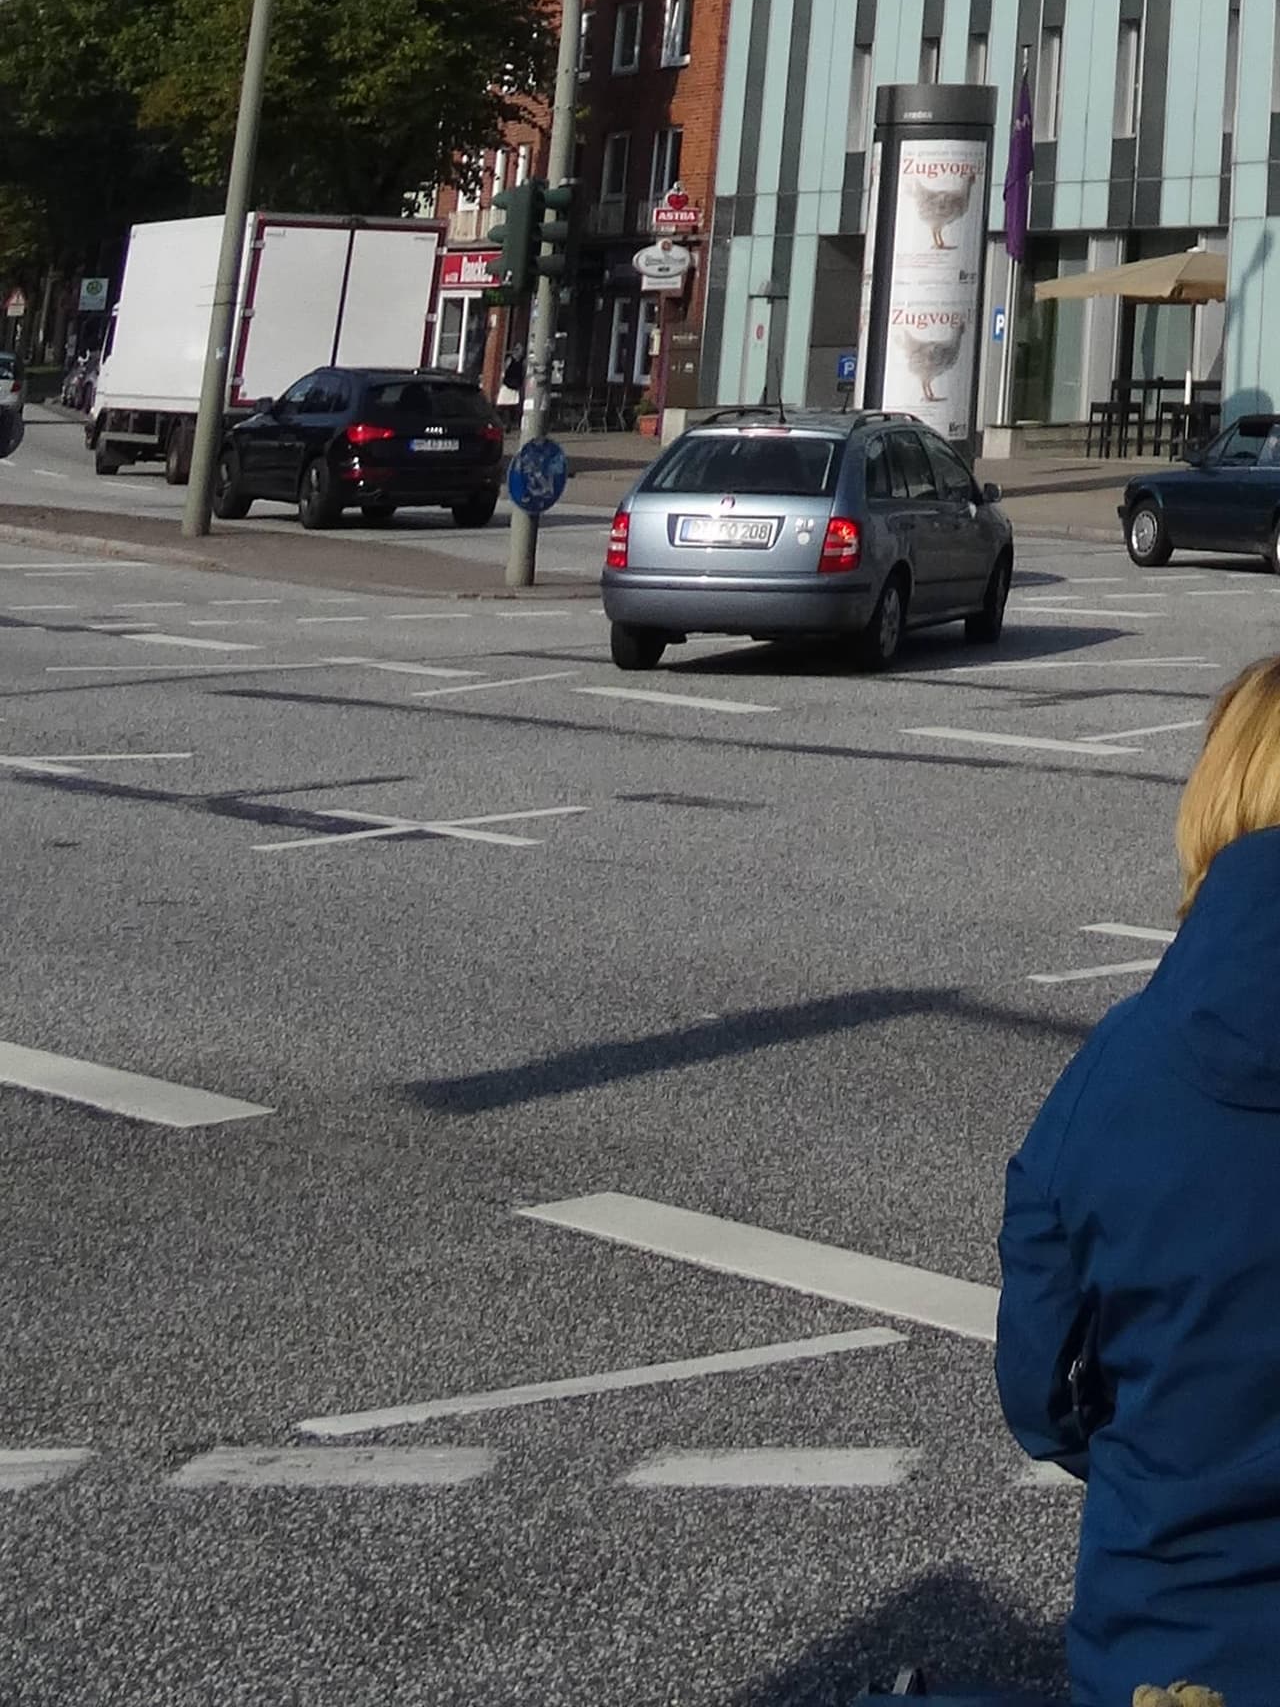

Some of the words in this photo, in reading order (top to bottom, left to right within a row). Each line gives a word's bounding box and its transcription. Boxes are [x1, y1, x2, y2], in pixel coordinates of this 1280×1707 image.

[657, 211, 696, 221] ASTRA
[995, 313, 1005, 335] P
[844, 360, 855, 376] P
[741, 524, 768, 540] 208
